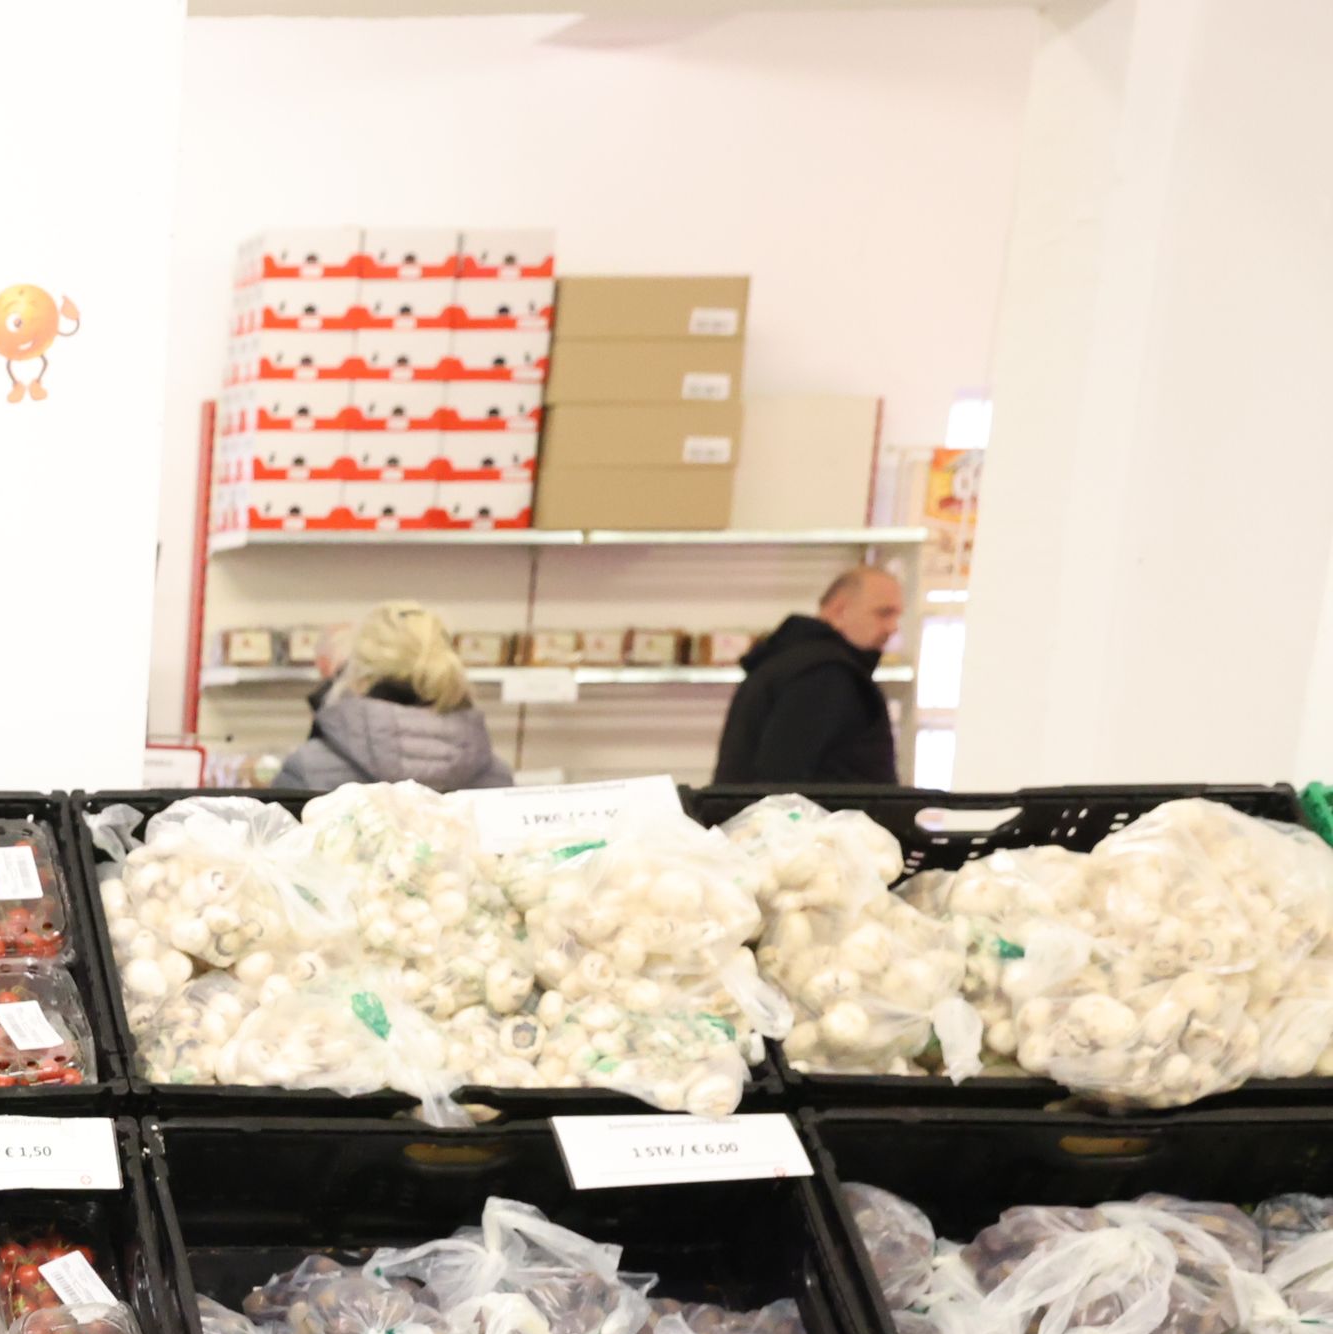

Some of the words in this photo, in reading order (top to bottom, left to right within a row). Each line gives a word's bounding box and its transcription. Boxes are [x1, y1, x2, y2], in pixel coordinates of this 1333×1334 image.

[5, 1146, 14, 1158] €
[20, 1146, 52, 1159] 1,50
[633, 1147, 640, 1159] 1
[646, 1146, 674, 1158] STK
[691, 1144, 701, 1155] €
